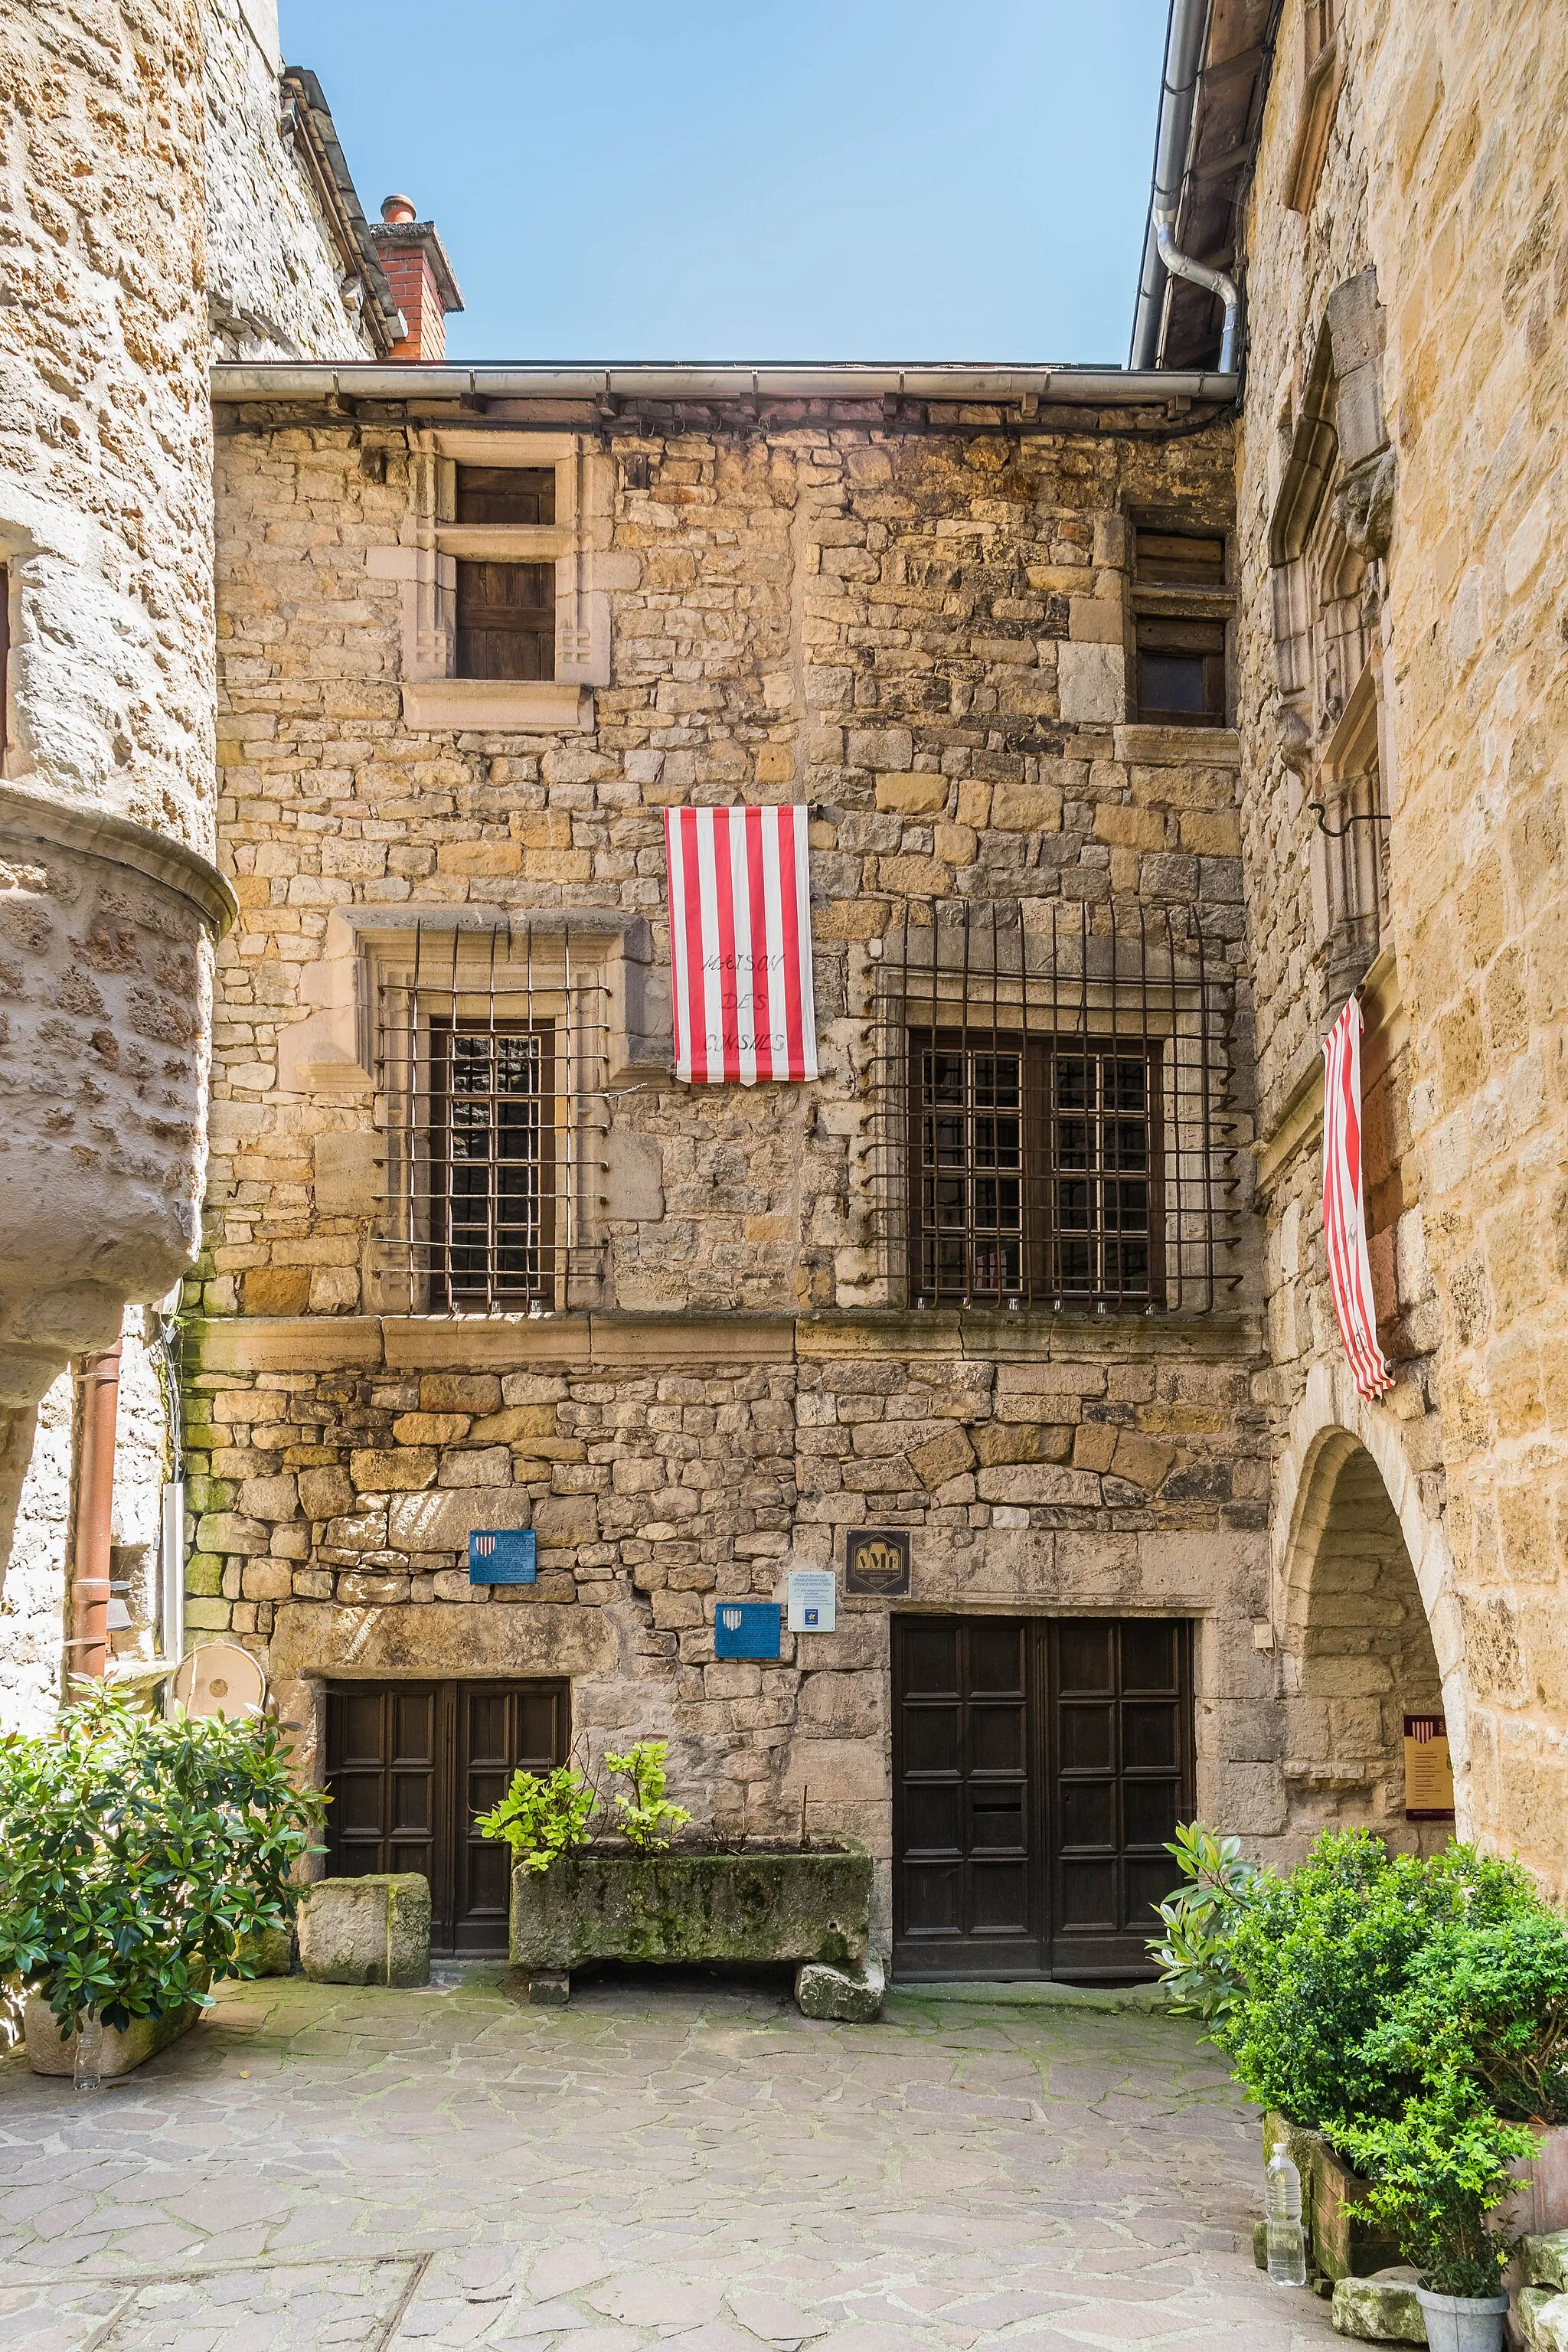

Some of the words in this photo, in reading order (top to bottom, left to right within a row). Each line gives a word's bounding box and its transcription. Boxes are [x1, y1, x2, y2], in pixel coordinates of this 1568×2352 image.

[701, 954, 786, 972] MAISON
[718, 992, 768, 1011] DES
[859, 1553, 897, 1569] VMF
